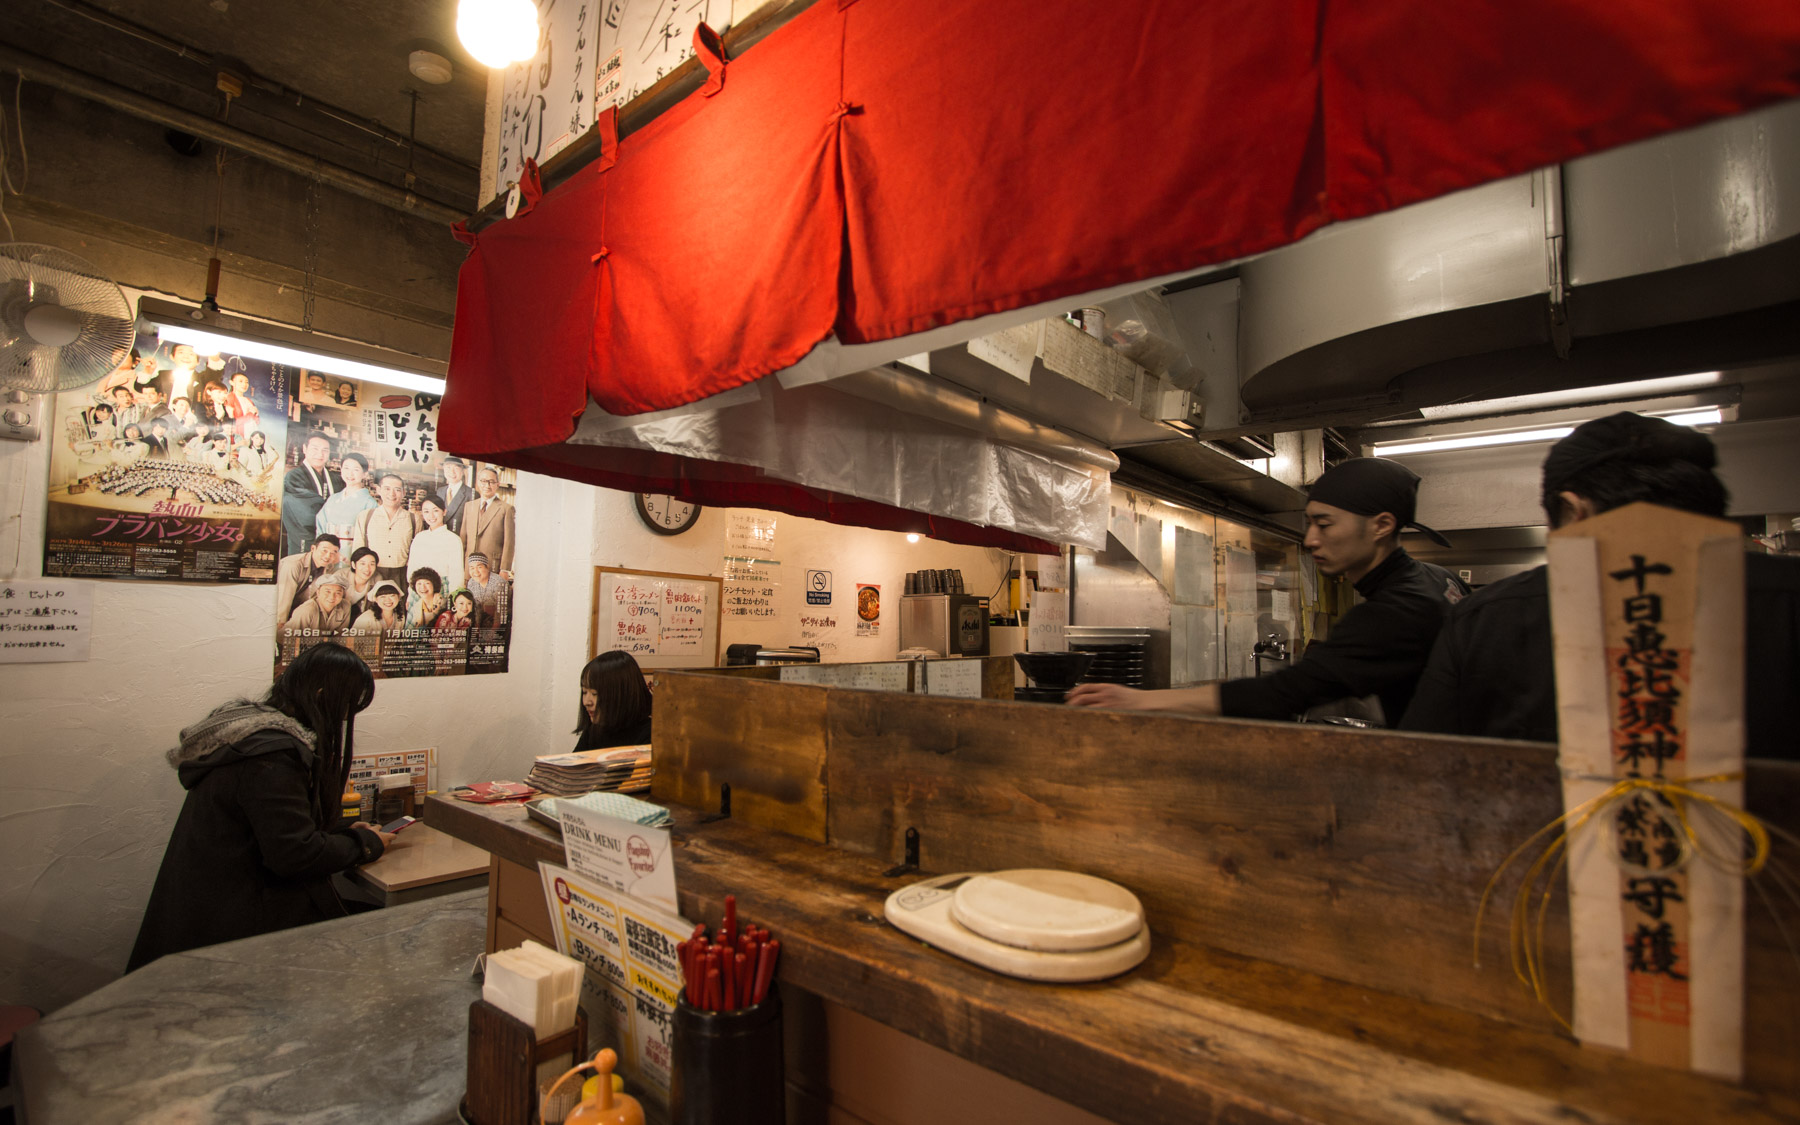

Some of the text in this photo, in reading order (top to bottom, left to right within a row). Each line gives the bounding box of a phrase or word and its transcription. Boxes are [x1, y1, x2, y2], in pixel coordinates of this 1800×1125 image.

[389, 412, 411, 462] ぴりり
[647, 502, 654, 512] 8
[682, 506, 688, 515] 4
[655, 511, 661, 520] 7
[665, 515, 671, 525] 6
[675, 513, 681, 522] 5
[92, 515, 245, 543] ブラバン少女。
[0, 588, 65, 599] 食・セットの
[614, 584, 660, 600] 台湾ラーメン
[674, 605, 702, 615] 1100円
[961, 620, 980, 631] Asahi
[284, 628, 320, 637] 3月6日
[341, 628, 366, 637] 29日
[1609, 555, 1681, 779] 十日恵比須神
[564, 822, 592, 842] DRINK
[593, 832, 621, 853] MENU
[570, 907, 600, 934] Aランチ
[1621, 877, 1690, 981] 守護
[575, 938, 607, 968] Bランチ
